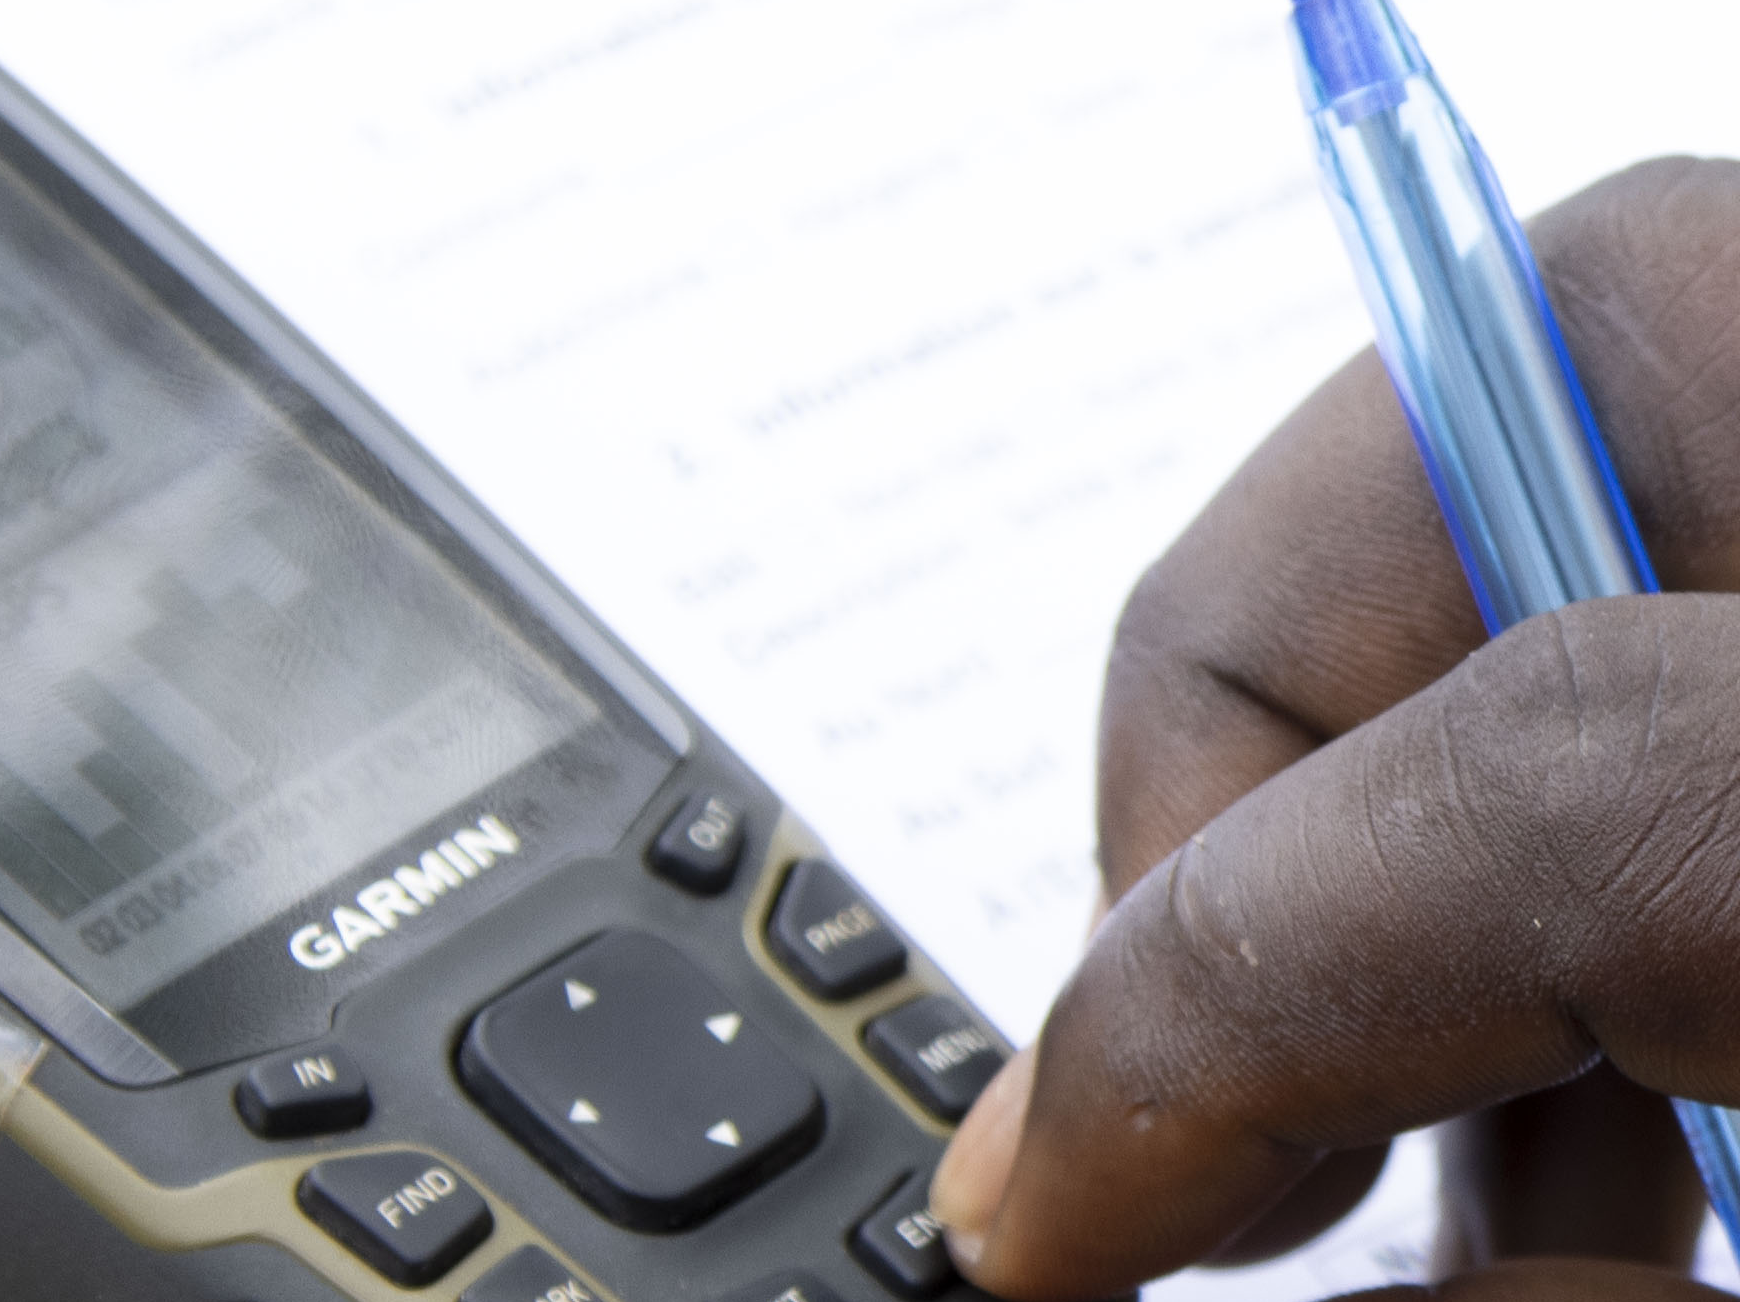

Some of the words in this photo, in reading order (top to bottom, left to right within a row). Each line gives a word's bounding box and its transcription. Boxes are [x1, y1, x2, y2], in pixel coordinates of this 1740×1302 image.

[687, 797, 737, 851] OUT
[288, 813, 519, 972] GARMIN
[291, 1053, 334, 1088] IN
[916, 1024, 993, 1075] MENU
[376, 1165, 457, 1232] FIND
[895, 1208, 944, 1250] EN
